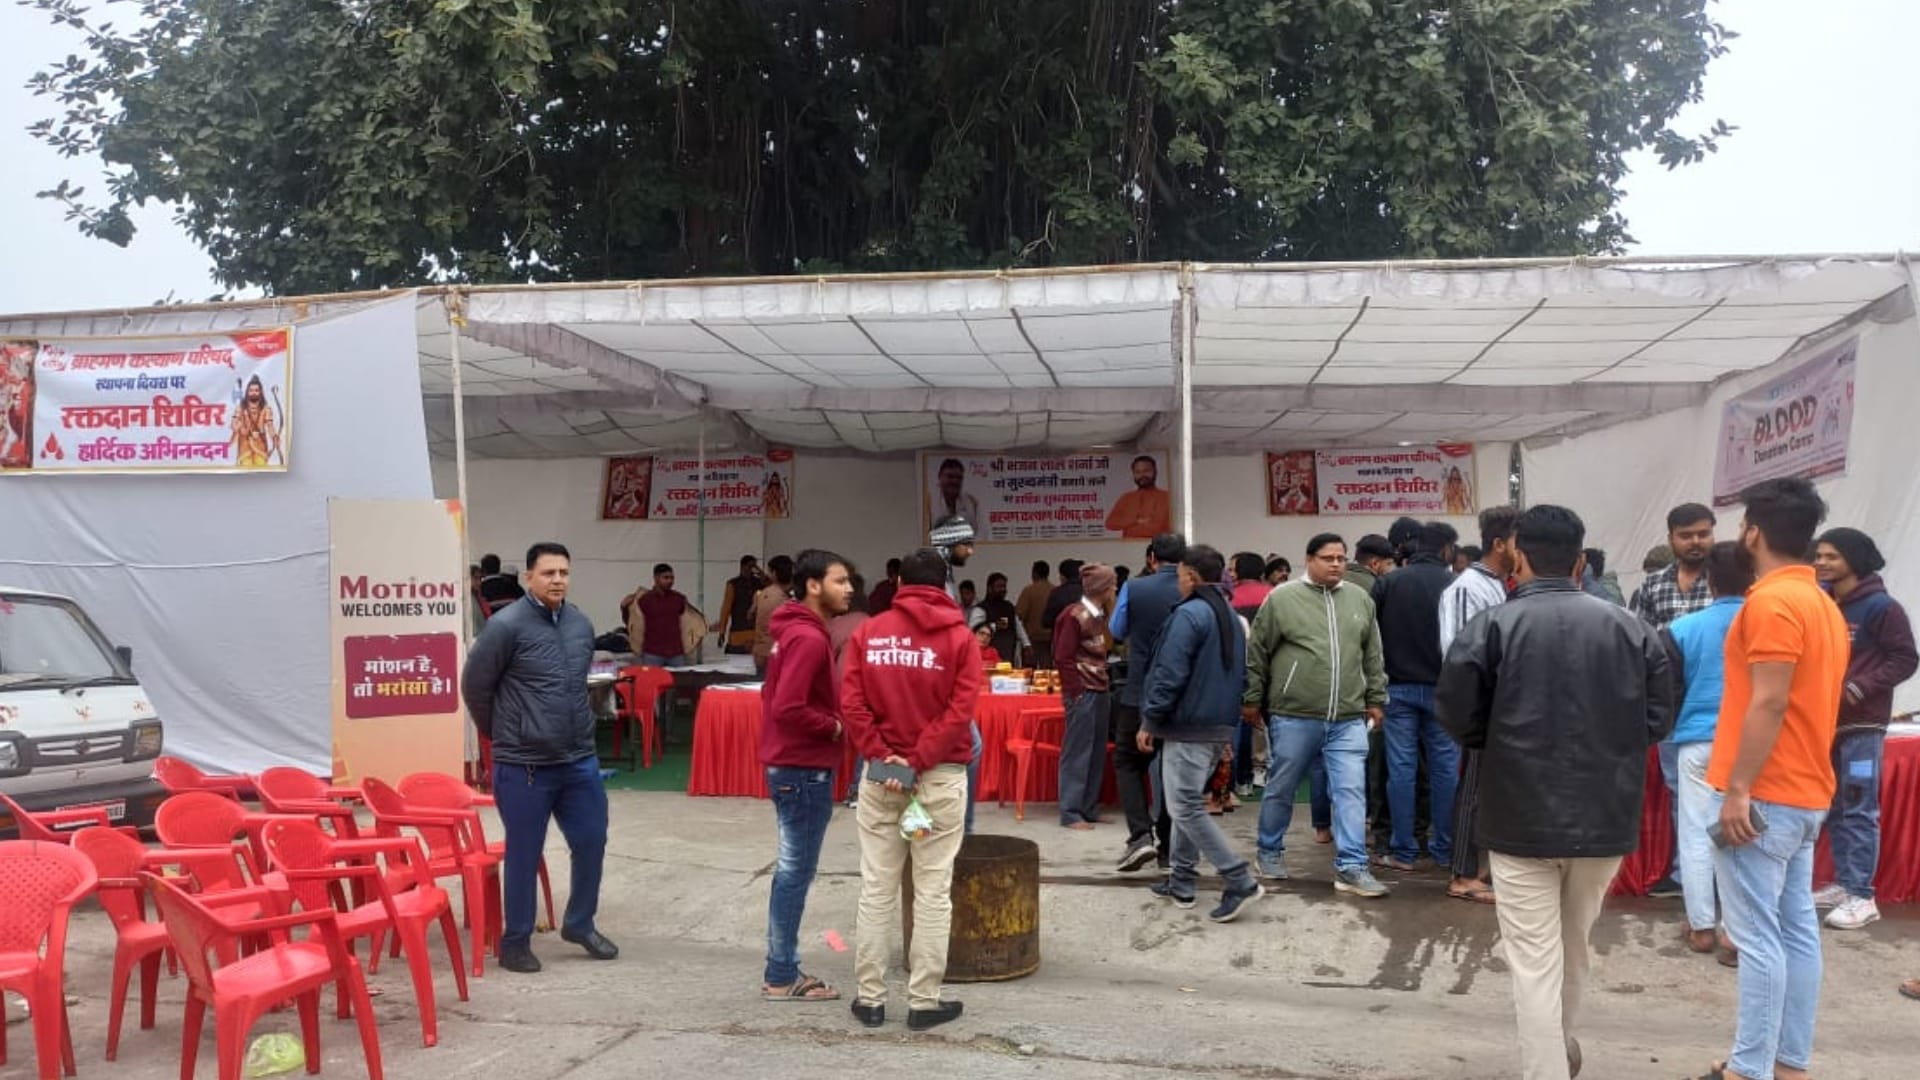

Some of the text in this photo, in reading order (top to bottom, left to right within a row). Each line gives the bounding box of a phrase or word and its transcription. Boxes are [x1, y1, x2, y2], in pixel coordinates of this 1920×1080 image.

[170, 375, 187, 389] पर
[61, 394, 226, 430] रक्तदान शिविर
[1754, 395, 1818, 445] BLOOD
[78, 436, 231, 462] हार्दिक अभिनन्दन
[1754, 441, 1788, 464] Donation
[342, 602, 456, 617] WELCOMES YOU
[364, 656, 416, 674] मोशन
[866, 646, 920, 667] भरोसा
[353, 676, 373, 697] तो
